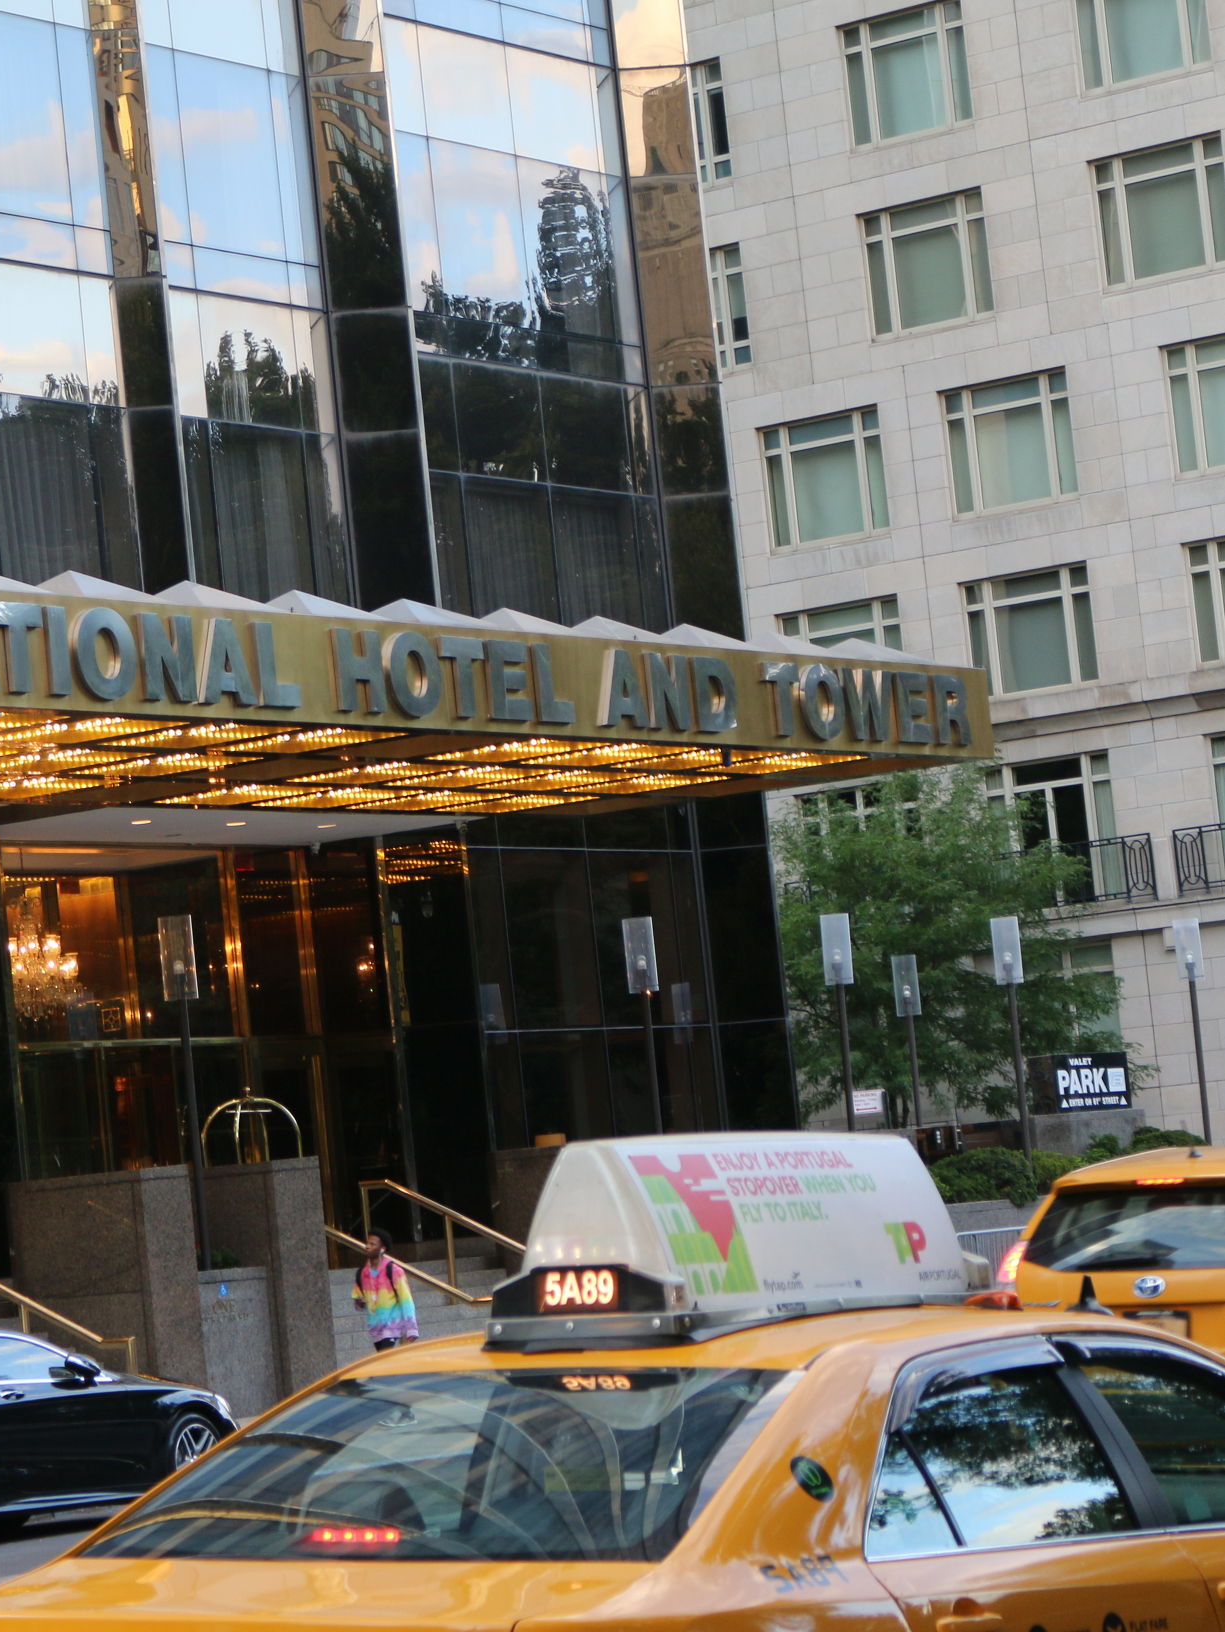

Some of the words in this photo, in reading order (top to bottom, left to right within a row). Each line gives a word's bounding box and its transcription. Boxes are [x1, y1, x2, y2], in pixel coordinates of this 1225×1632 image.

[329, 626, 575, 725] HOTEL
[595, 648, 738, 733] AND
[759, 661, 973, 746] TOWER
[1068, 1057, 1093, 1066] VALET
[1057, 1068, 1108, 1095] PARK
[1069, 1098, 1085, 1107] ENTER
[1085, 1097, 1093, 1106] ON
[1102, 1096, 1120, 1105] STREET
[711, 1152, 762, 1171] ENJOY
[762, 1152, 776, 1169] A
[776, 1150, 855, 1170] PORTUGAL
[726, 1175, 803, 1197] STOPOVER
[798, 1173, 848, 1195] WHEN
[844, 1172, 878, 1193] YOU
[738, 1202, 764, 1224] FLY
[763, 1201, 787, 1223] TO
[785, 1200, 830, 1222] ITALY.
[883, 1221, 927, 1265] TAP
[545, 1269, 614, 1306] 5A89
[763, 1278, 804, 1293] flytap.com
[759, 1554, 850, 1593] 5A89
